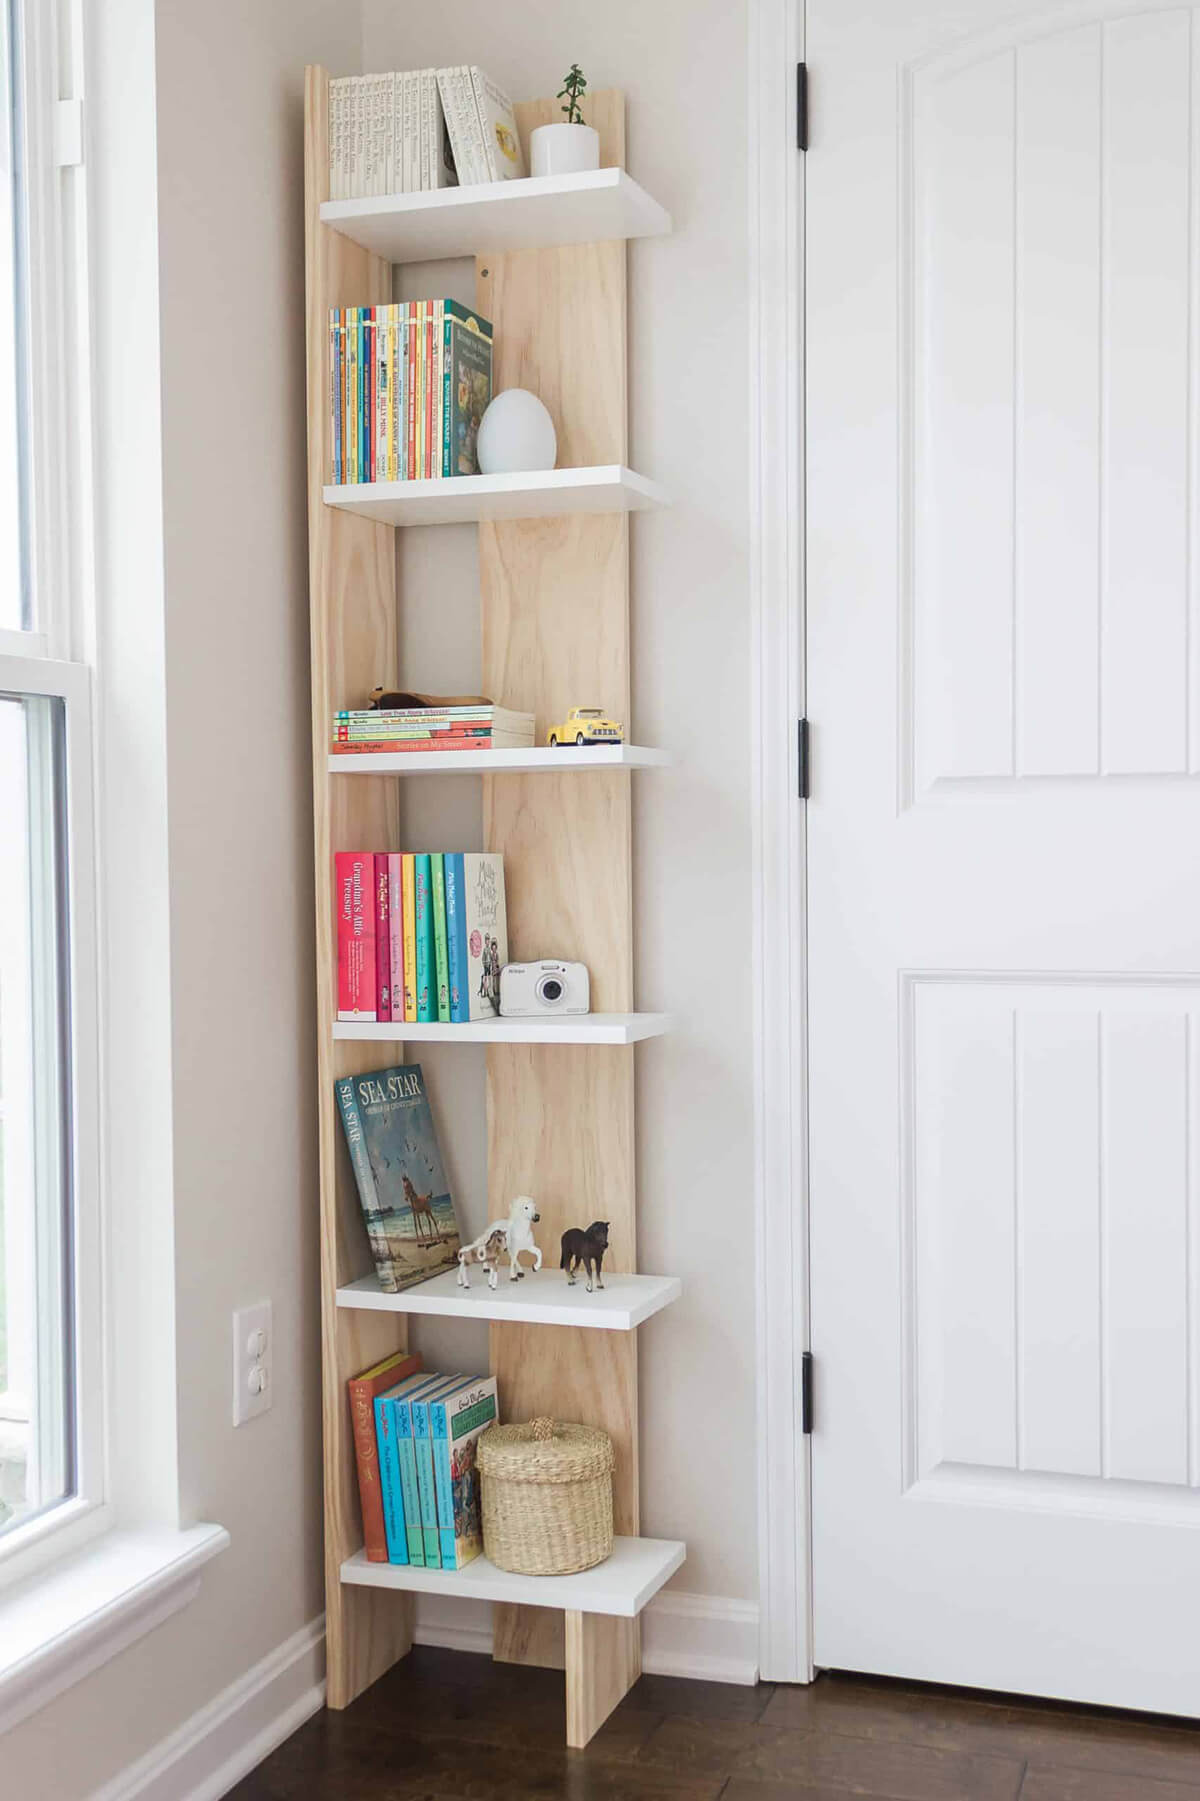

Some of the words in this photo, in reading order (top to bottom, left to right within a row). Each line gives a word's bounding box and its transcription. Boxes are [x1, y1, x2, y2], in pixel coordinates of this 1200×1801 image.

[341, 876, 354, 922] Treasury
[352, 861, 365, 913] Grandma's
[352, 914, 365, 936] Attic
[339, 1086, 353, 1109] SEA
[359, 1080, 387, 1105] SEA
[387, 1073, 421, 1099] STAR
[345, 1111, 361, 1143] STAR
